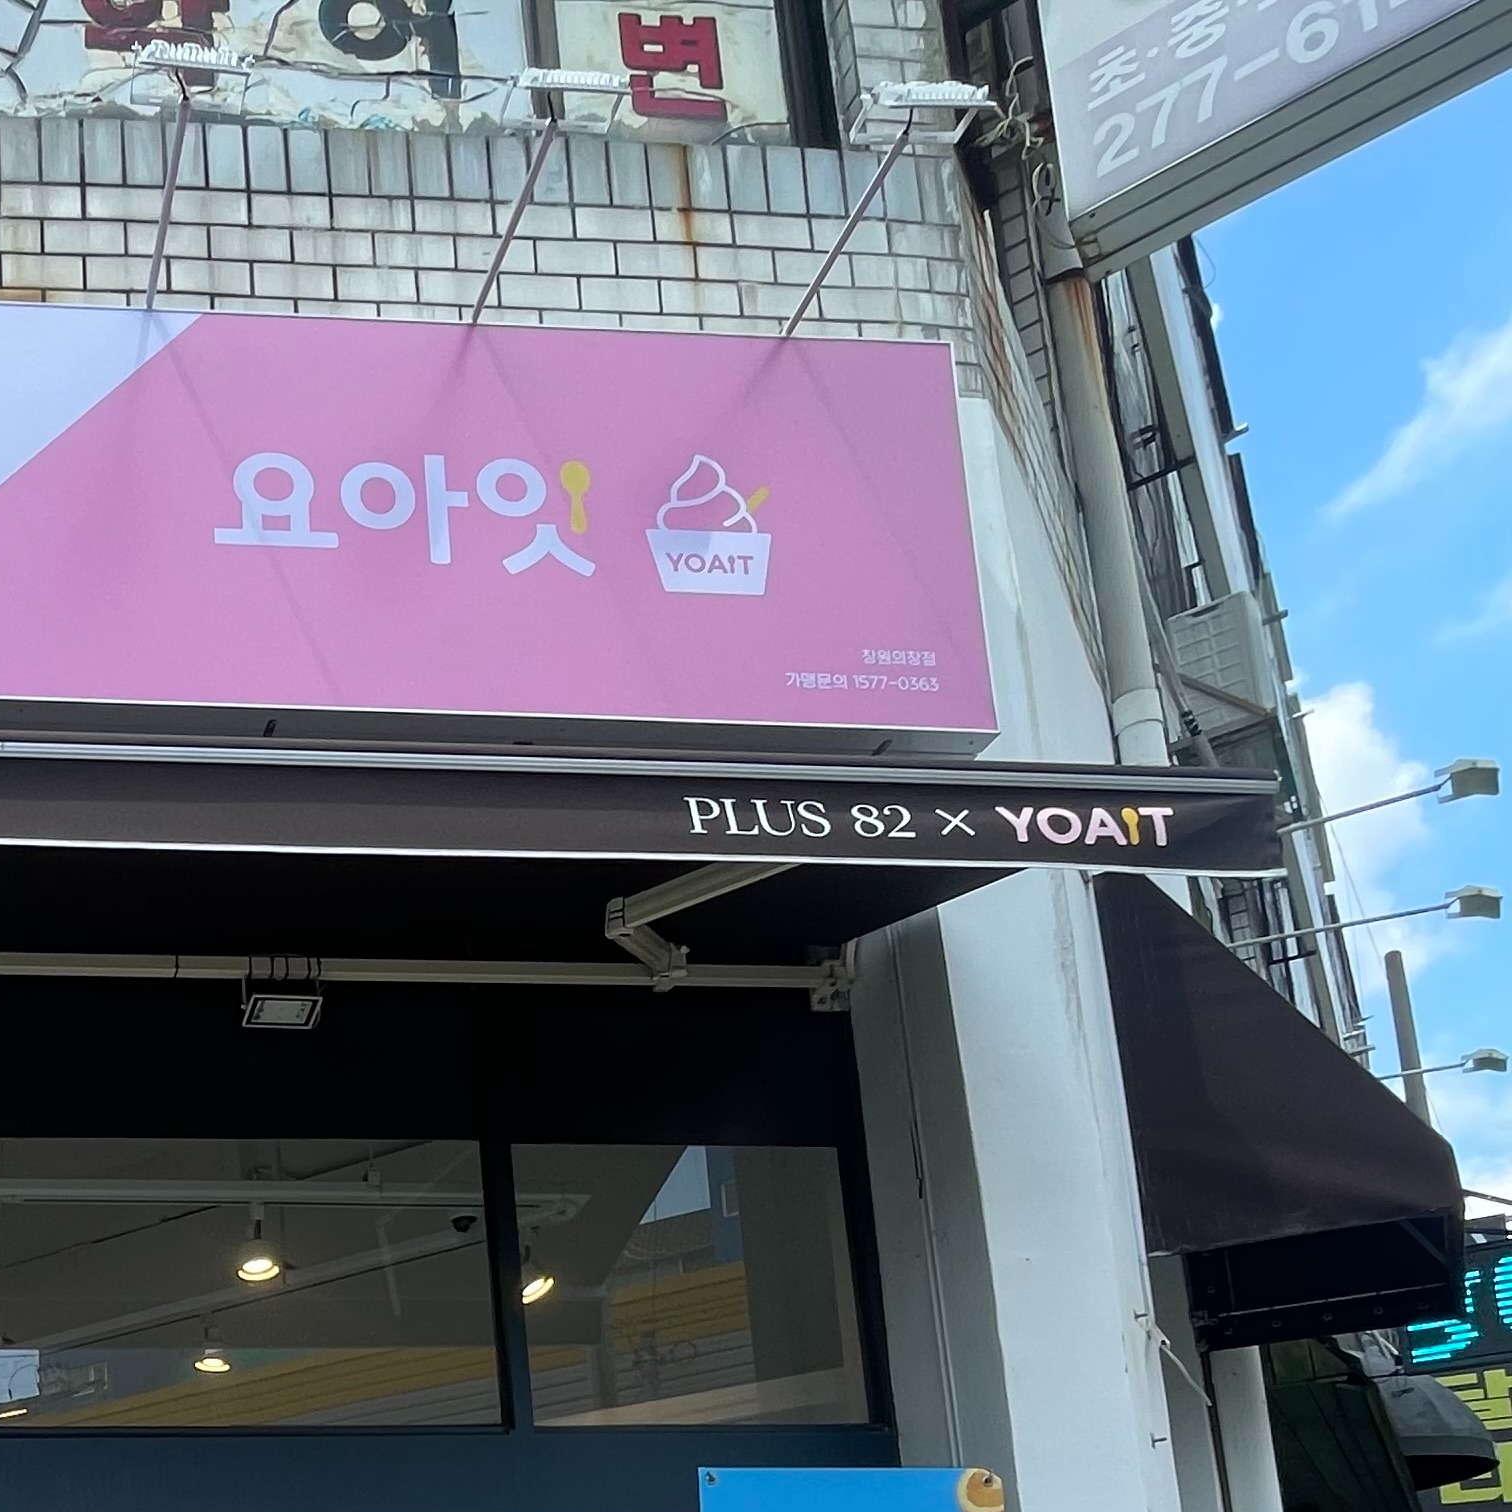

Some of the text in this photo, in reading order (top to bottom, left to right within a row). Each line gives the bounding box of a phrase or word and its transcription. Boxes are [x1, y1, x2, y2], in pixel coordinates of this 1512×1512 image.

[214, 452, 596, 578] 요아잇
[665, 553, 754, 577] YOAIT
[785, 673, 939, 692] 가맹문의 1577-0363
[684, 797, 831, 837] PLUS
[851, 804, 916, 838] 82
[996, 806, 1174, 847] YOAIT
